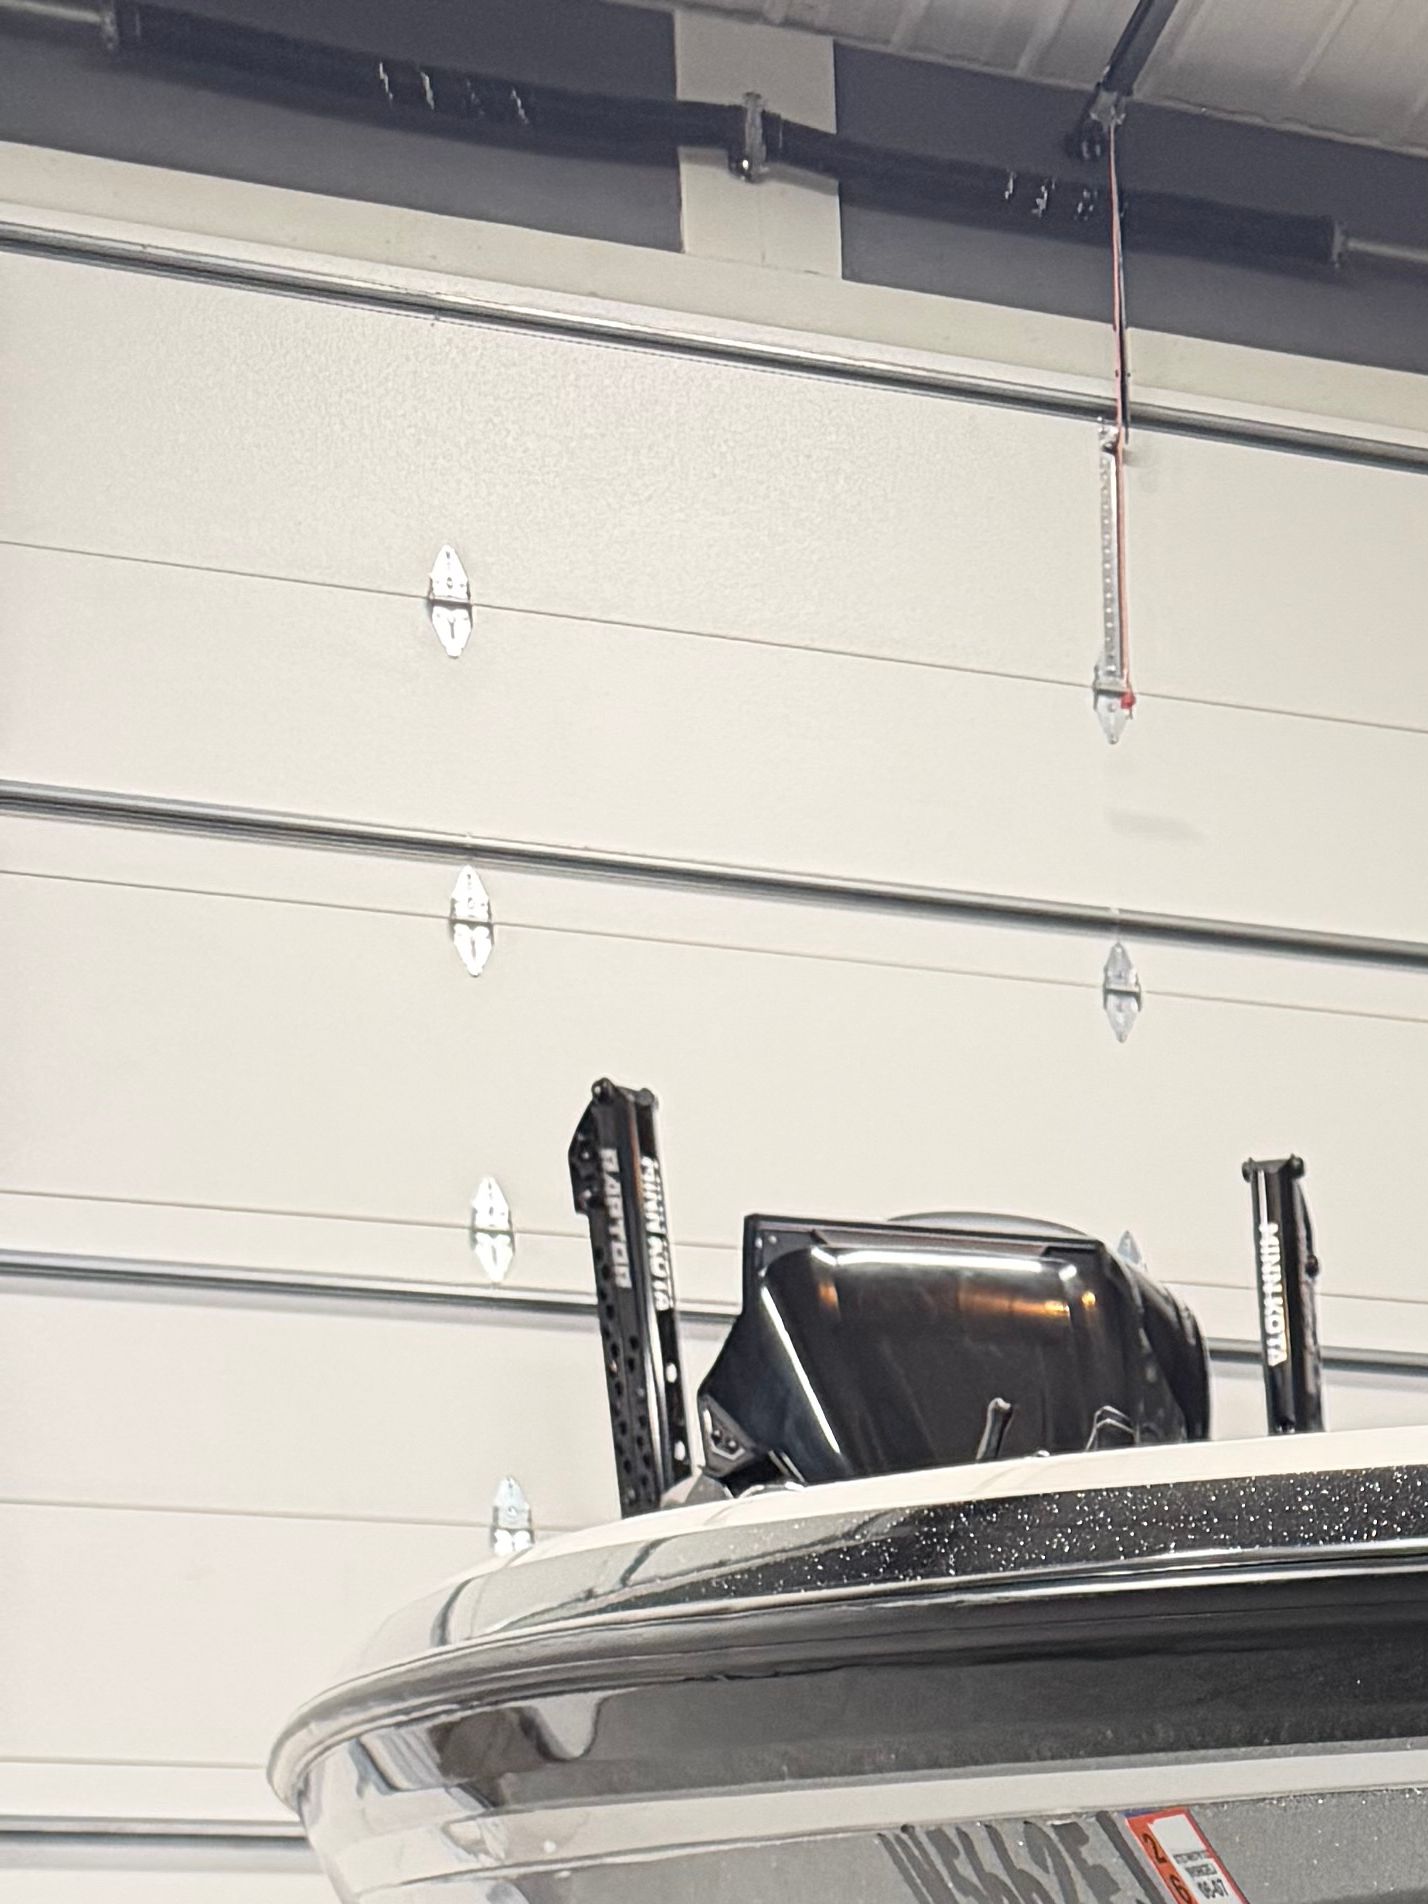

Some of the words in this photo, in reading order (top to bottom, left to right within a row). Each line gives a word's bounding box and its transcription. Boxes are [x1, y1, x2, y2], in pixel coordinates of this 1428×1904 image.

[599, 1149, 633, 1288] RAPTOR
[641, 1156, 667, 1235] MINN
[648, 1236, 674, 1311] KOTA
